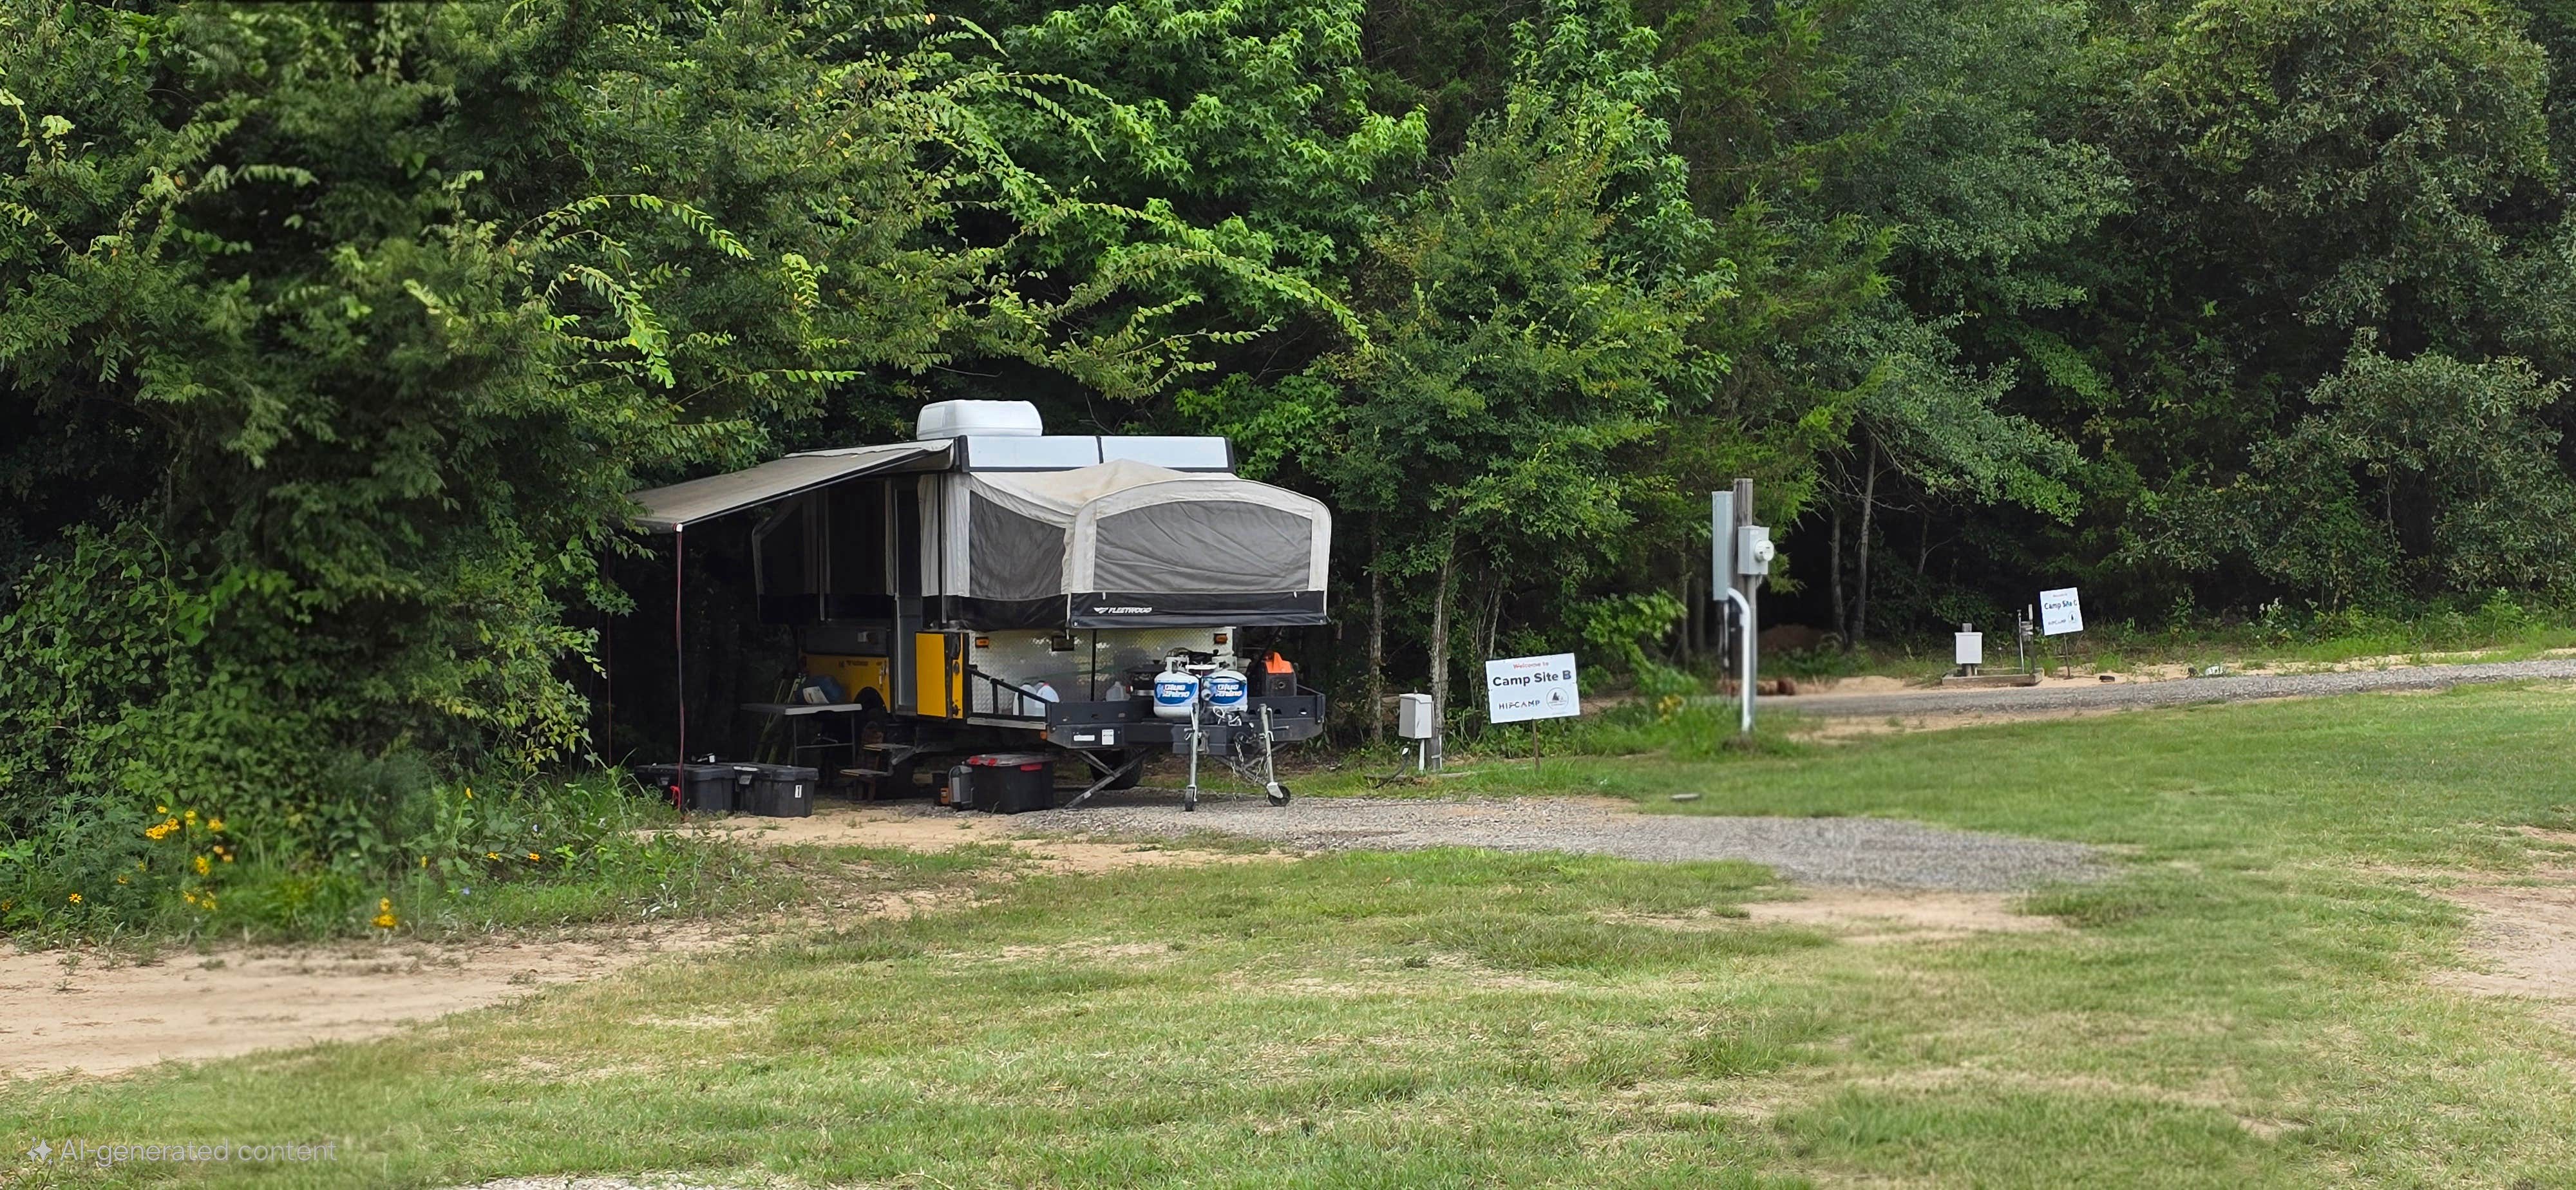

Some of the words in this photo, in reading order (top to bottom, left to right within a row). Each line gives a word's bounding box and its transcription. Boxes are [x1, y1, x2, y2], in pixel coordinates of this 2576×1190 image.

[1493, 675, 1530, 686] Camp
[1533, 672, 1558, 683] Site
[1562, 670, 1571, 680] B
